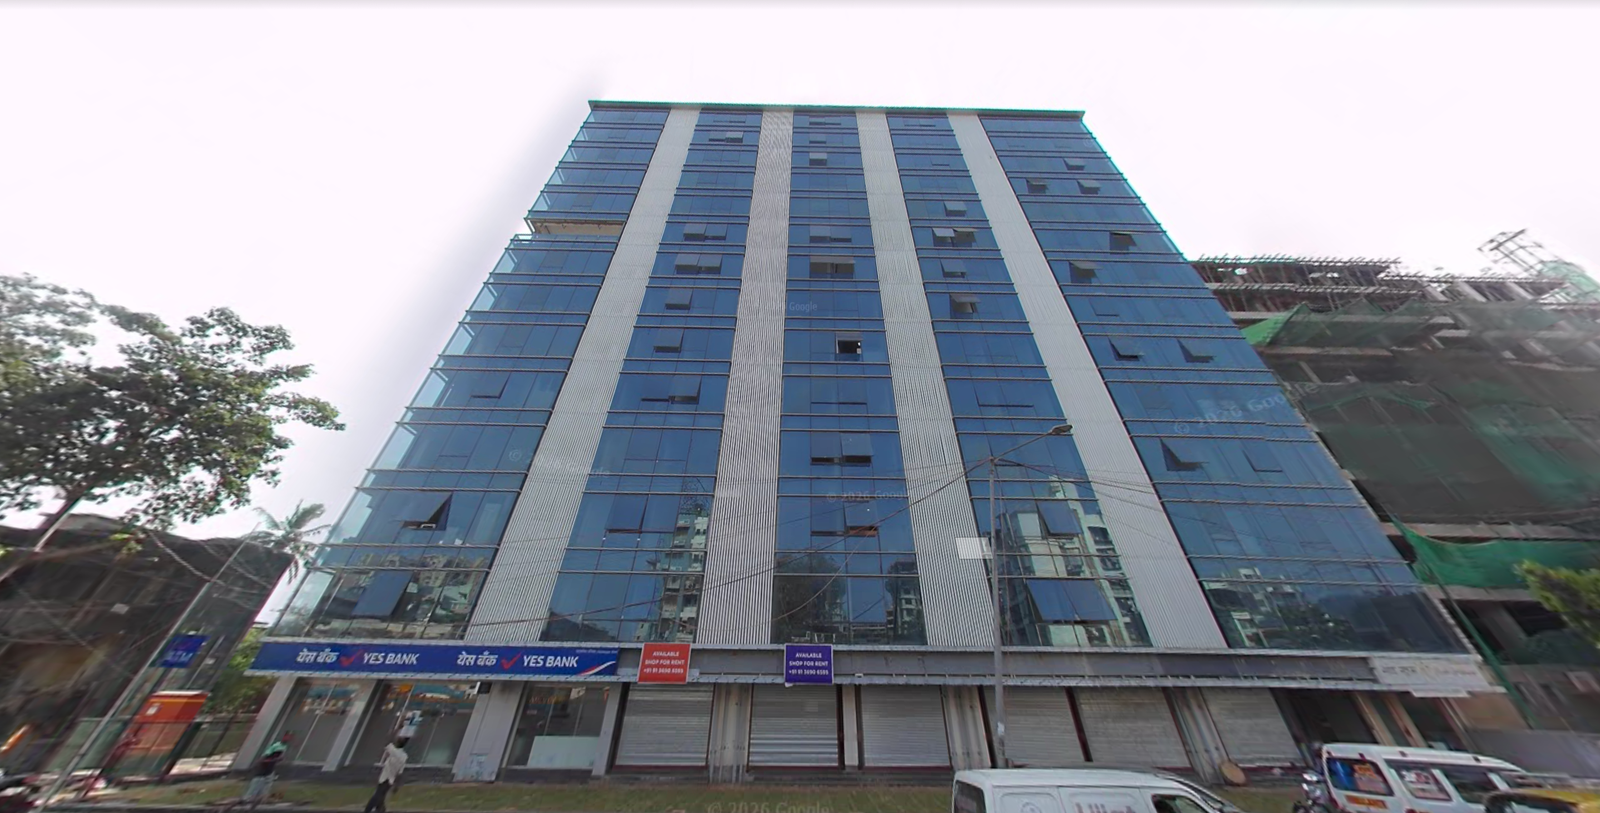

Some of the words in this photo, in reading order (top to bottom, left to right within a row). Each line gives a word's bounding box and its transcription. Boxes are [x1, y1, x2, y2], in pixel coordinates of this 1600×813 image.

[363, 652, 385, 665] YES
[385, 652, 419, 665] BANK
[456, 651, 476, 666] येस
[523, 655, 544, 667] YES
[545, 655, 579, 668] BANK
